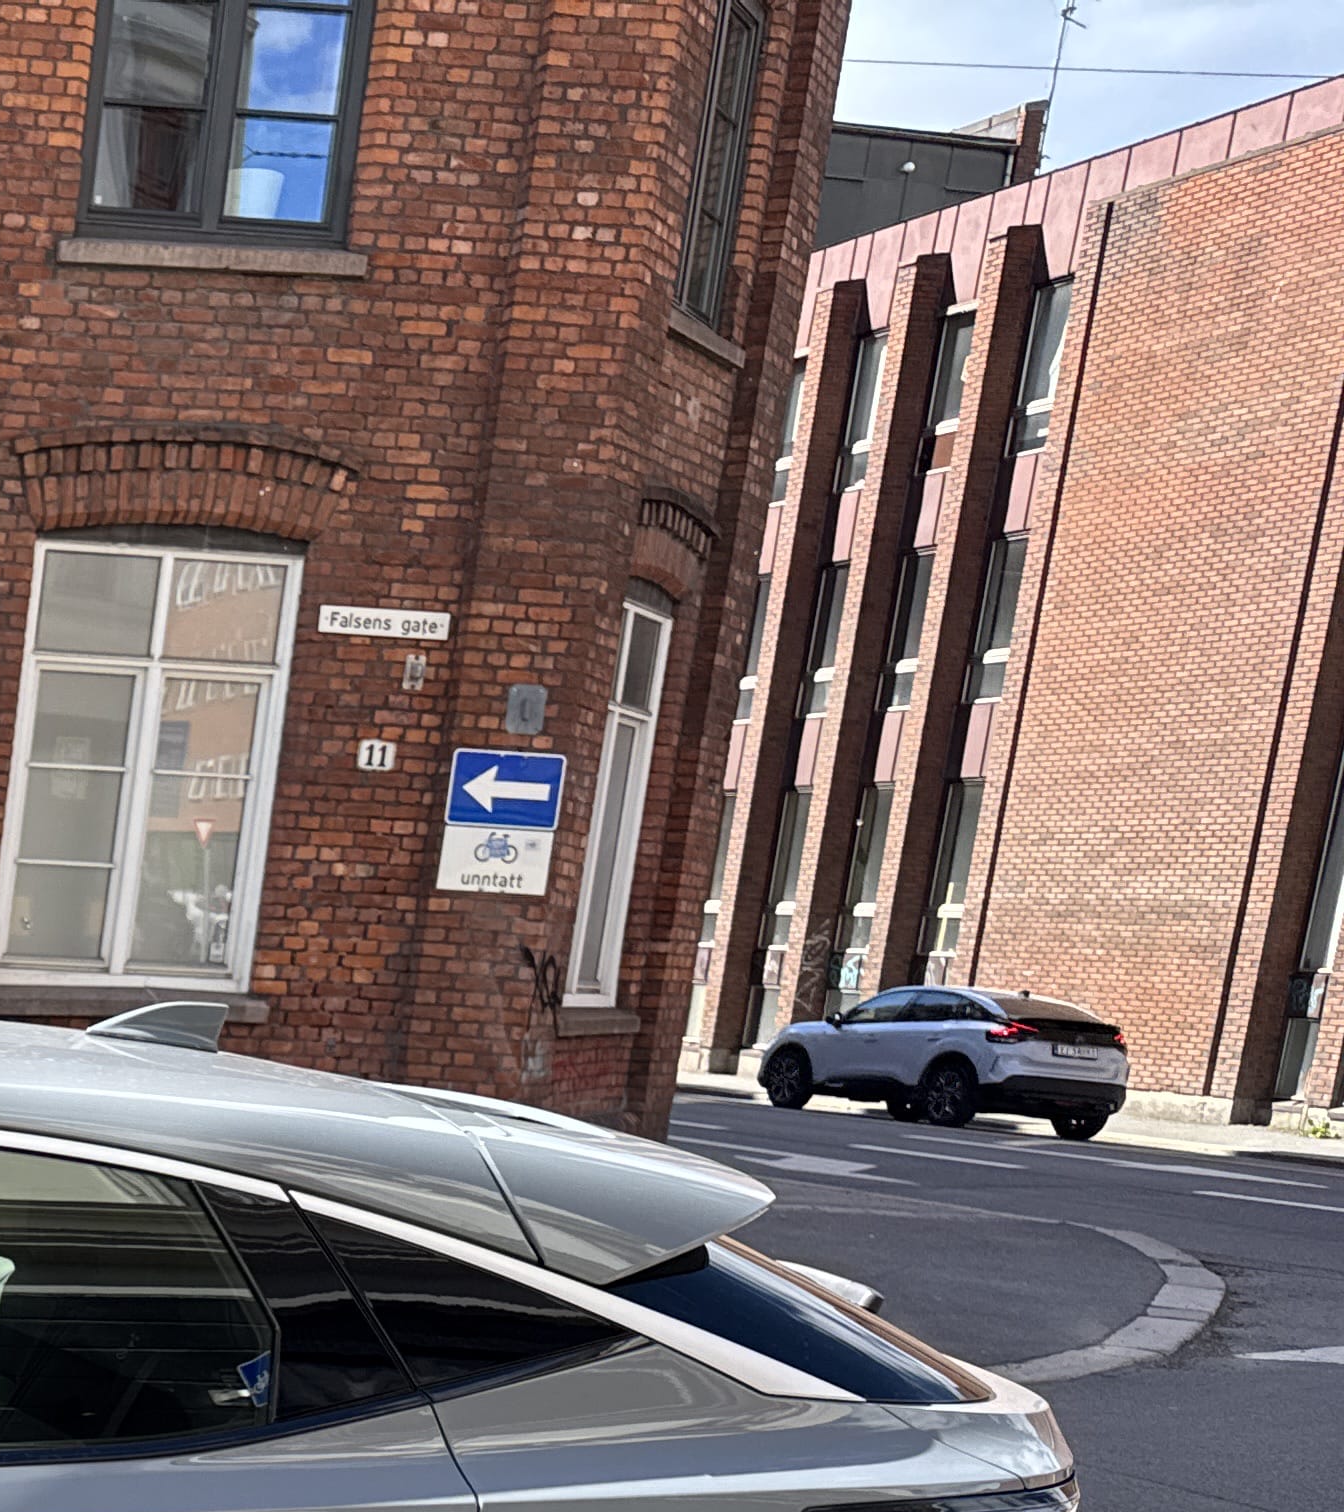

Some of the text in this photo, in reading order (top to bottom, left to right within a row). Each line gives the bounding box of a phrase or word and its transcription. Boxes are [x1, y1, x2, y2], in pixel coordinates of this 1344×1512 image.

[329, 611, 438, 635] Falsens gate
[365, 743, 387, 767] 11
[460, 872, 523, 889] unntatt
